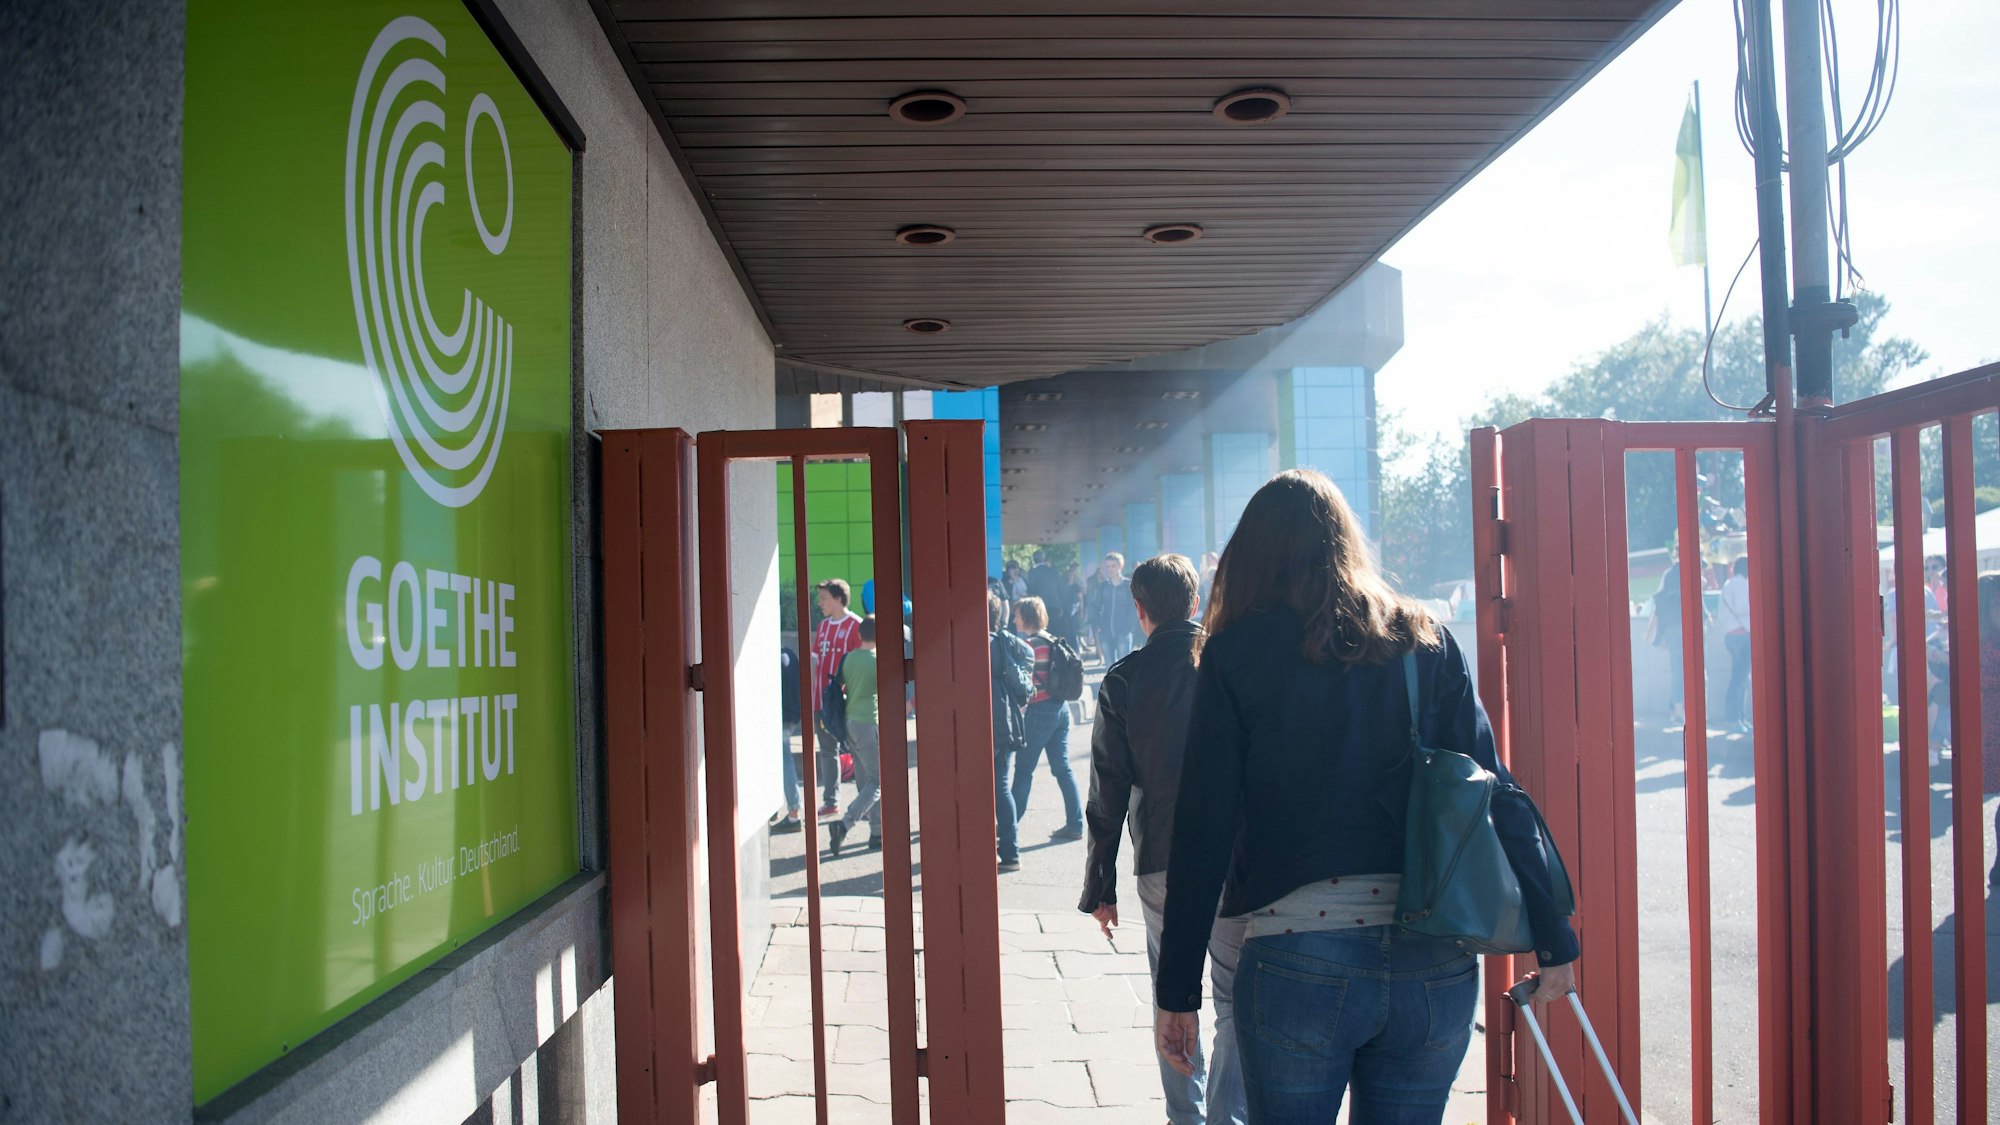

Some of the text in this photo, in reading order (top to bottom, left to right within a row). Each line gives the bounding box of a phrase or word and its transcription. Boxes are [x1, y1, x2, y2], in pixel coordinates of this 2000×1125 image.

[345, 555, 517, 671] GOETHE
[350, 693, 518, 817] INSTITUT
[351, 823, 521, 928] Sprache. Kultur. Deutschland.
